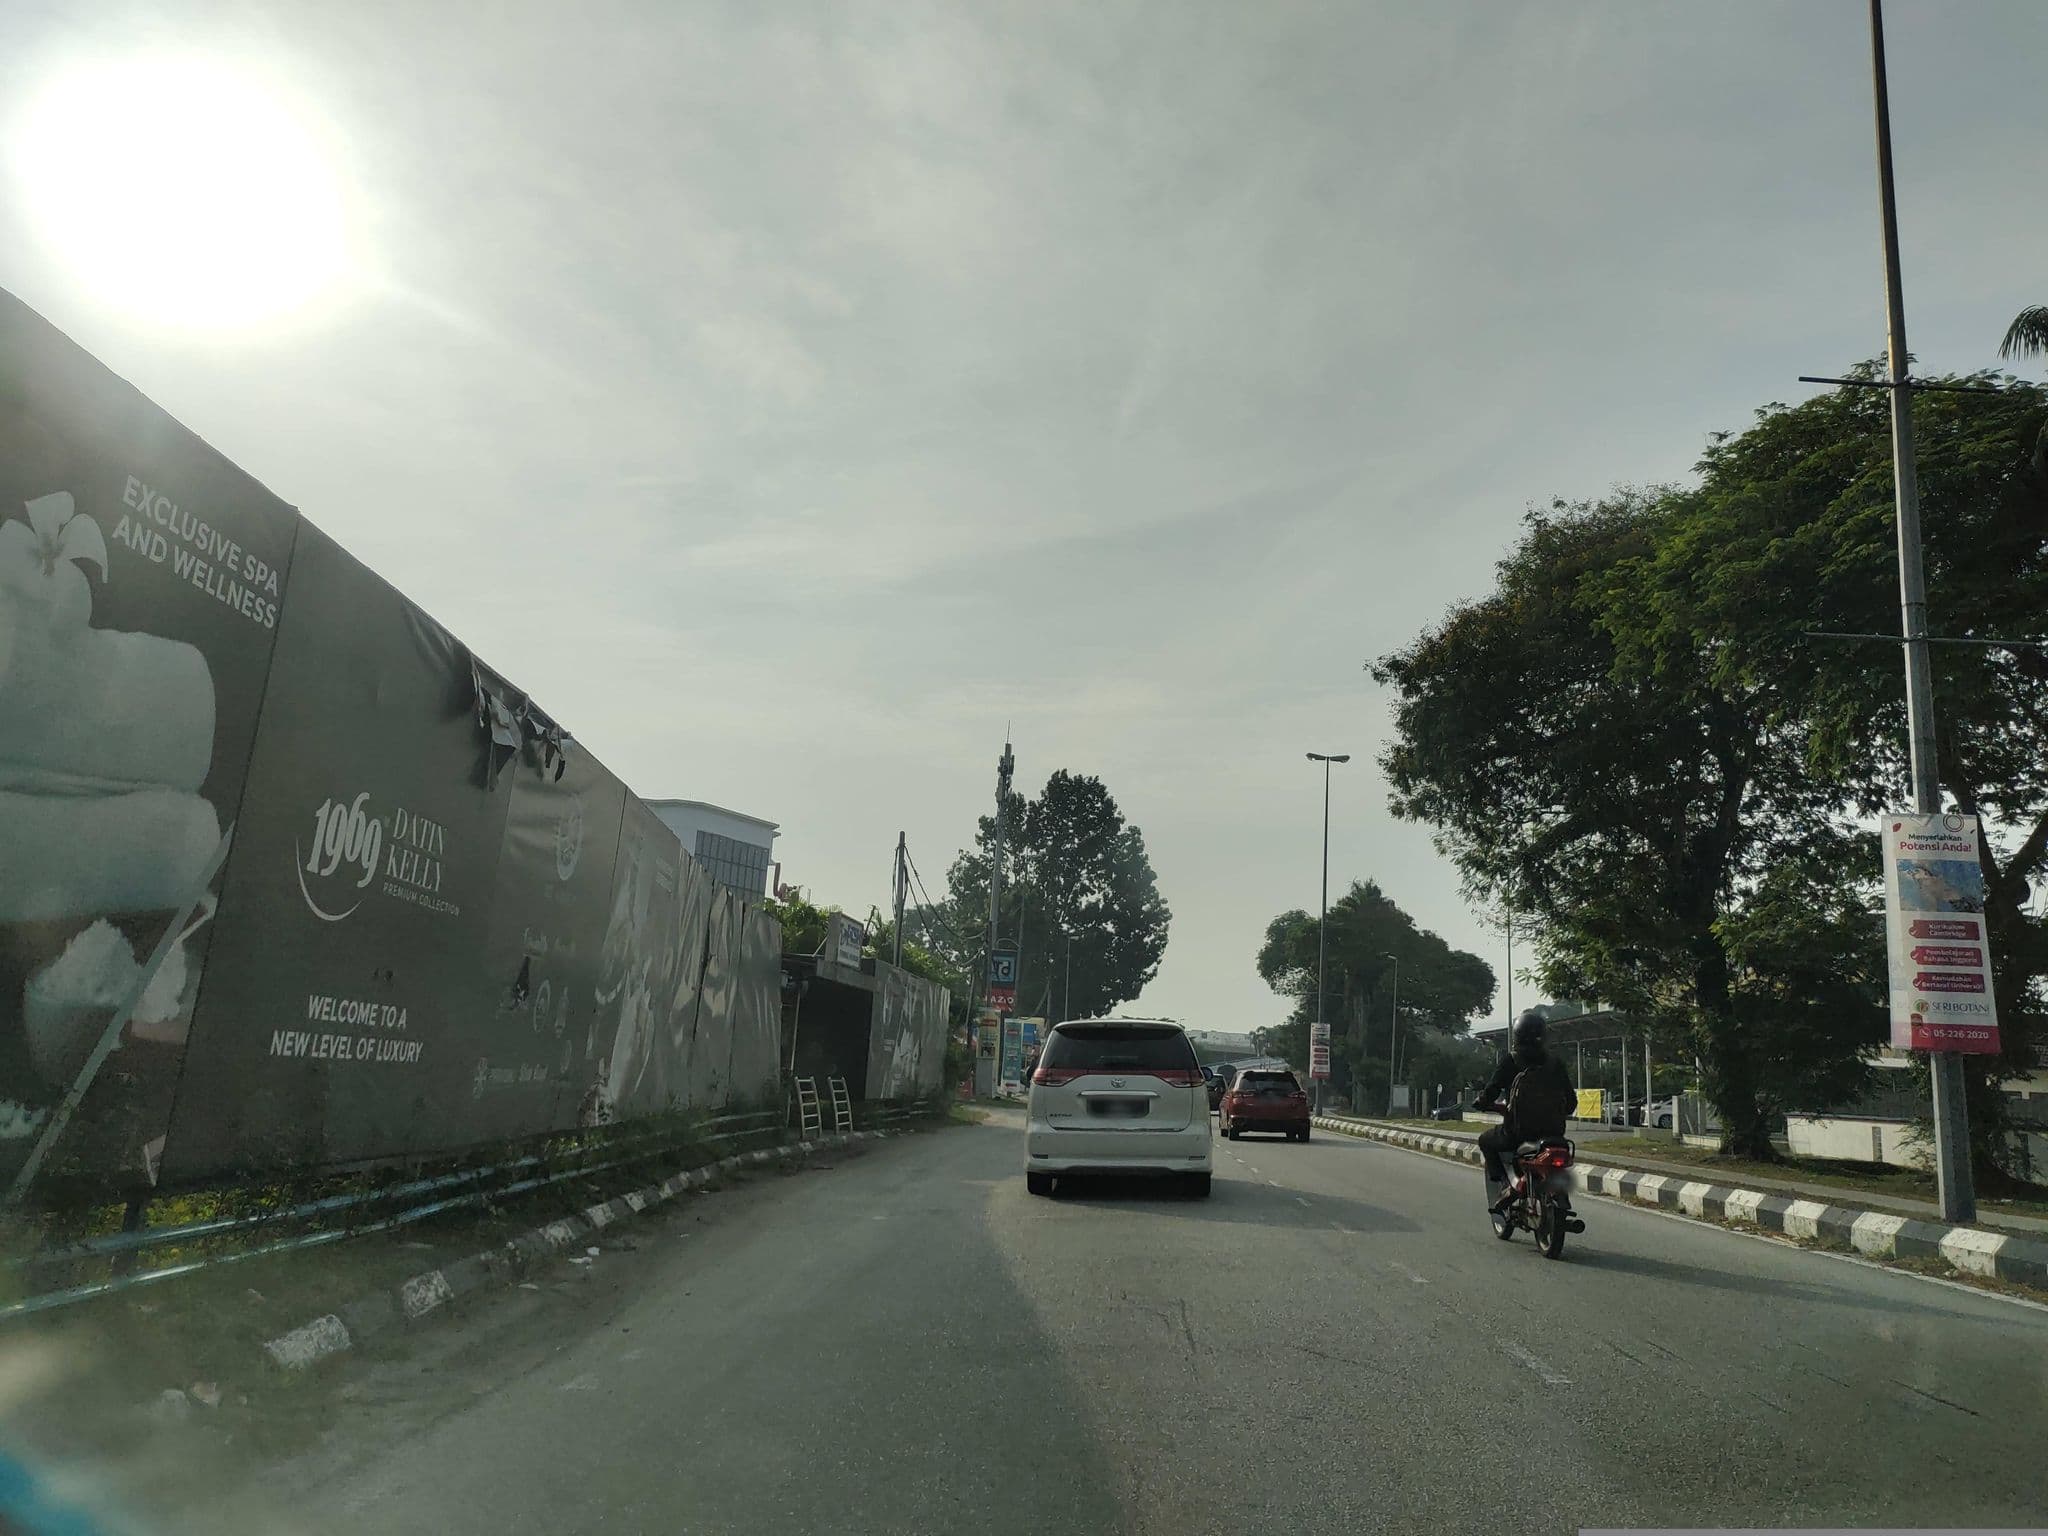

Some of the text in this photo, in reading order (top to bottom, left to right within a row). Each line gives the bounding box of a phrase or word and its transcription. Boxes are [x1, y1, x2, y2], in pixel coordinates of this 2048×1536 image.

[123, 474, 278, 597] EXCLUSIVE SPA
[112, 514, 277, 628] AND WELLNESS
[306, 792, 383, 889] 1969
[393, 808, 447, 855] DATIN
[1900, 841, 1972, 853] Potensi Anda!
[387, 843, 442, 892] KELLY
[383, 882, 462, 917] PREMIUM COLLECTION
[308, 994, 408, 1030] WELCOME TO A
[270, 1029, 423, 1063] NEW LEVEL OF LUXURY
[1933, 1029, 1989, 1039] 05-226 2020
